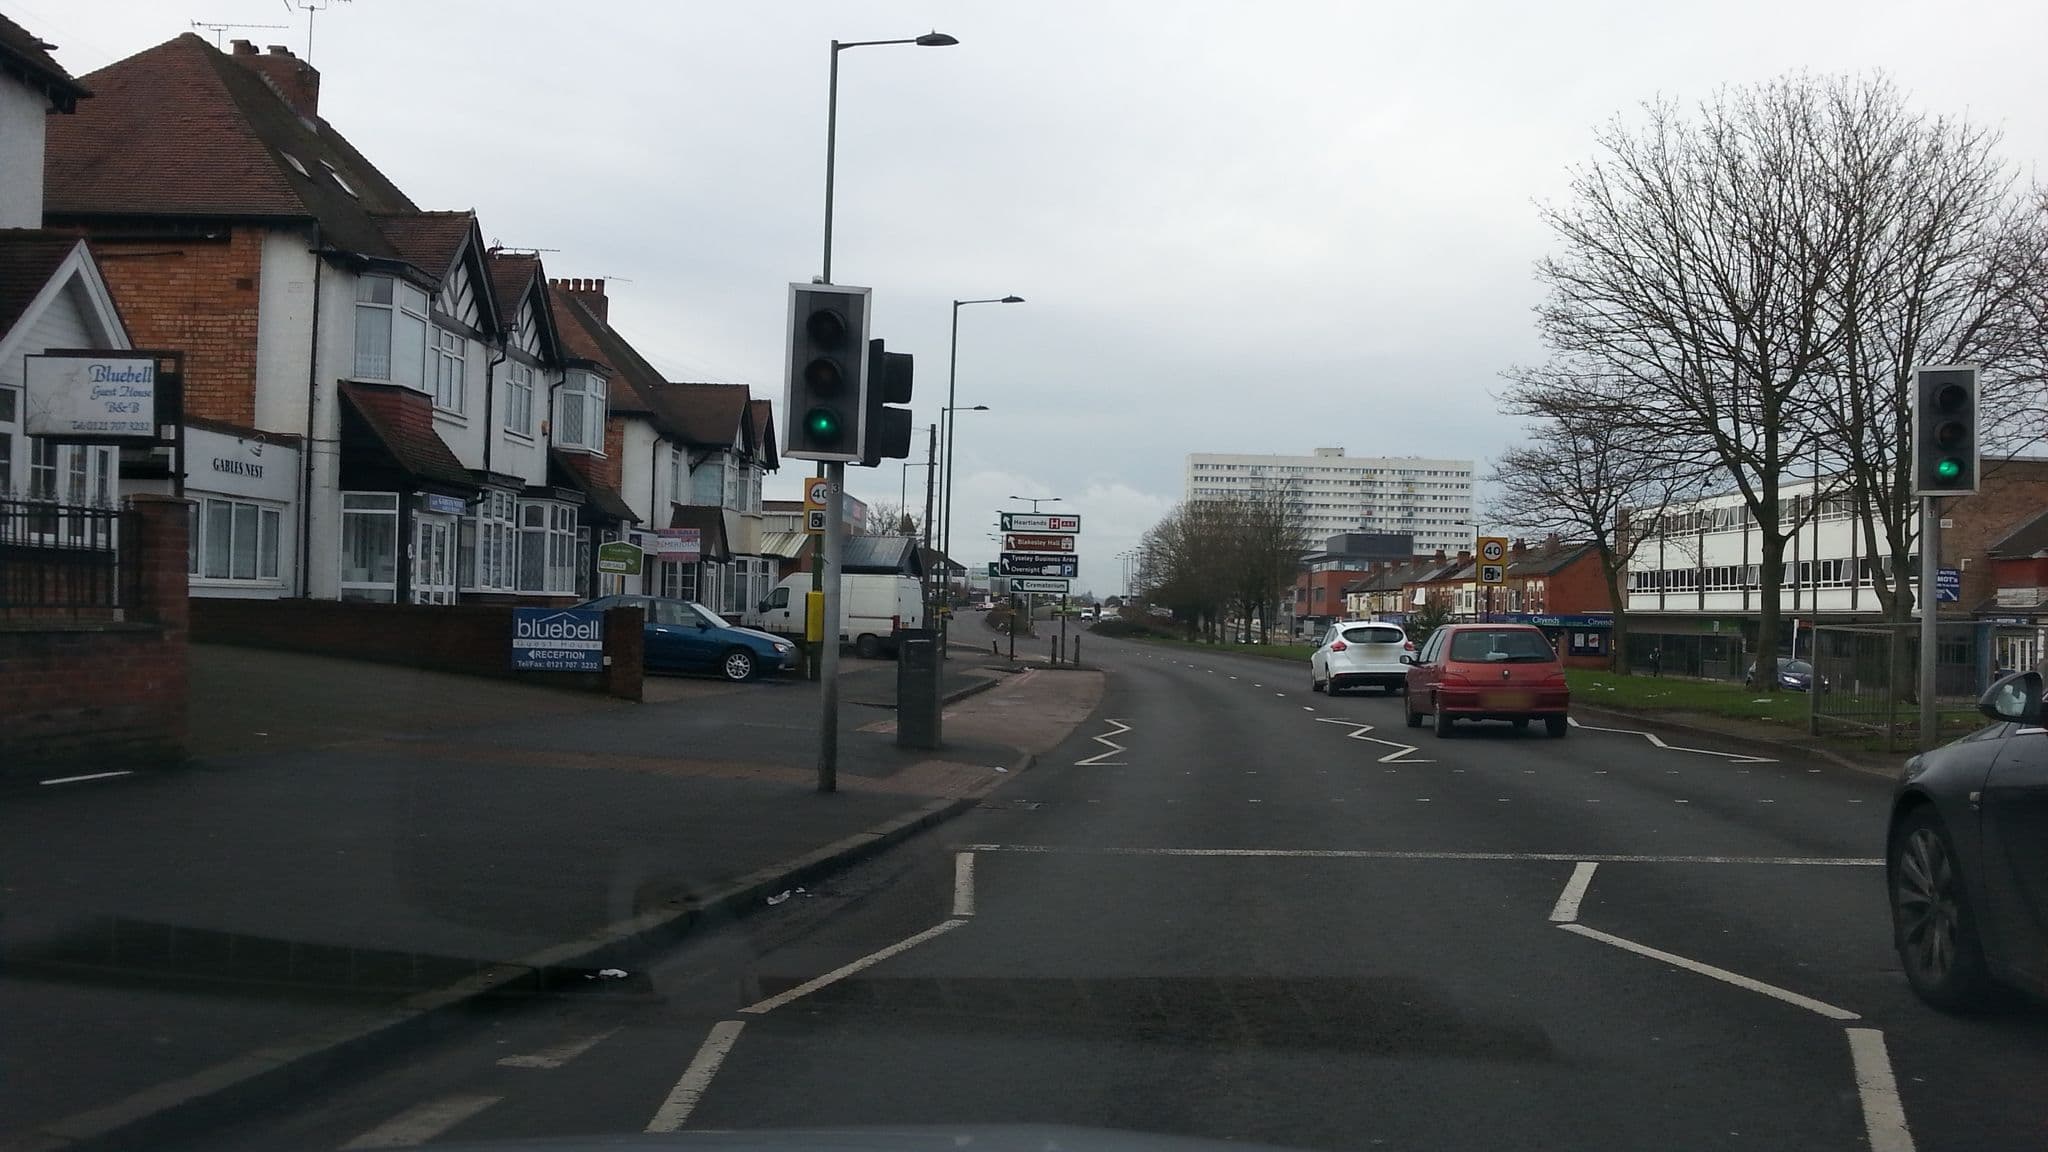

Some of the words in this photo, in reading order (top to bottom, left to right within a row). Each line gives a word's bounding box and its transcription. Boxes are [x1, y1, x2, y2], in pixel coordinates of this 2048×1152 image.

[88, 364, 152, 383] Bluebell
[90, 386, 118, 400] Guest
[119, 386, 152, 398] House
[213, 457, 243, 475] GABLES
[246, 463, 264, 478] NEST
[832, 484, 839, 493] 3
[1485, 546, 1501, 556] 40
[1011, 566, 1040, 574] Overnight
[517, 618, 599, 639] bluebell
[535, 650, 585, 659] RECEPTION
